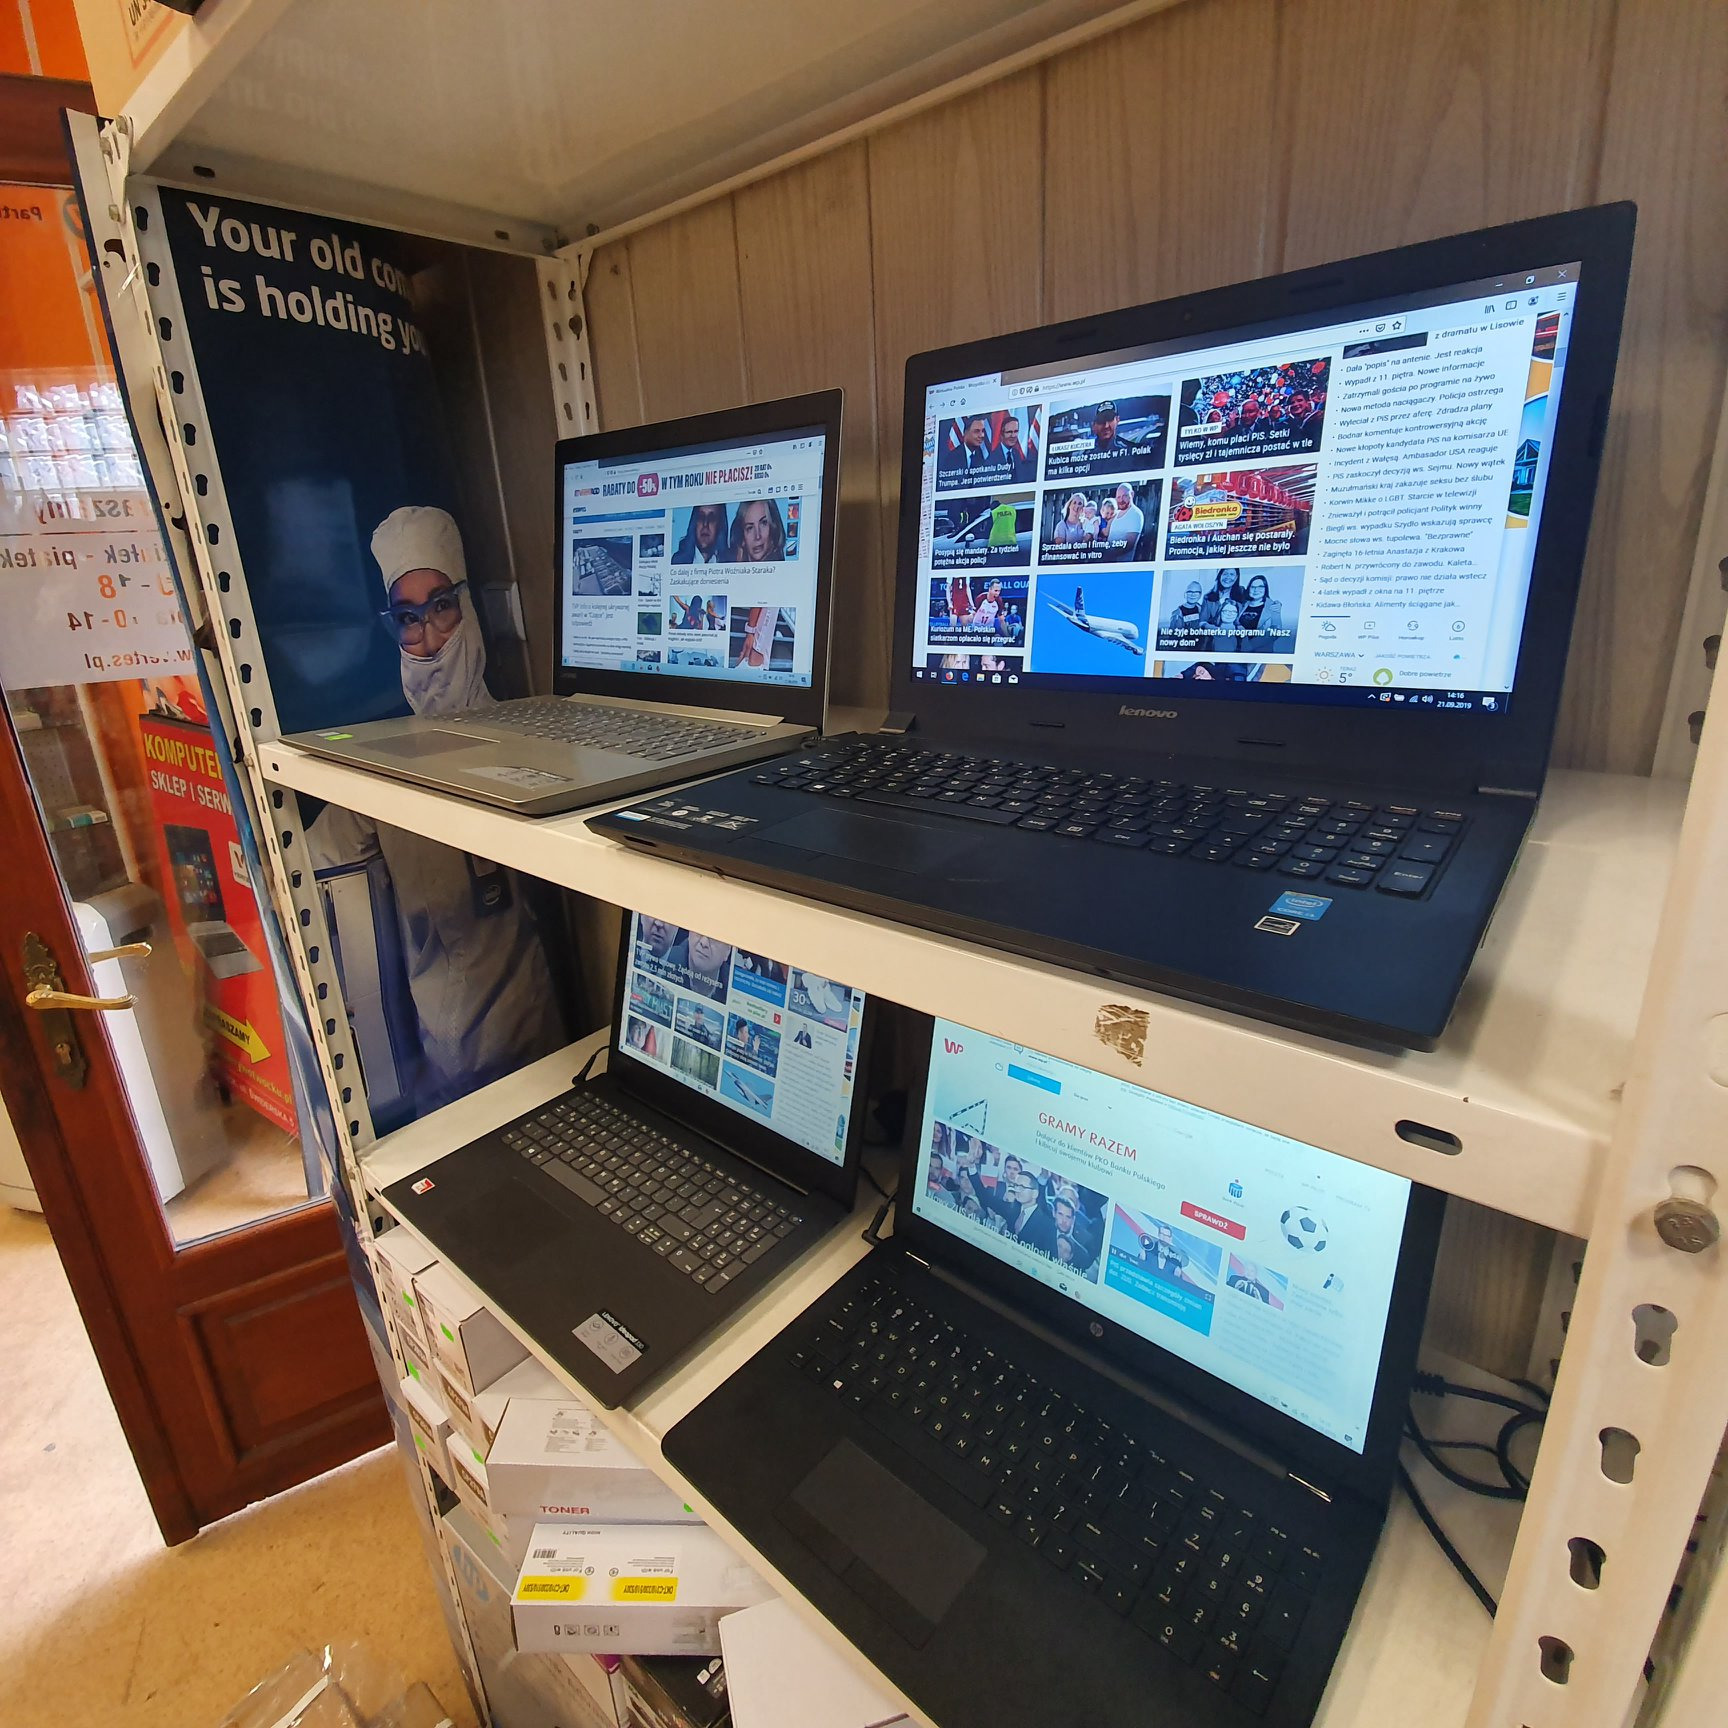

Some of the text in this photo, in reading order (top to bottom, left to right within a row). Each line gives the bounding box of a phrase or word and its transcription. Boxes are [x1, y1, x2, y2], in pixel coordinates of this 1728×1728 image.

[186, 202, 297, 262] Your
[310, 233, 364, 280] old
[201, 266, 246, 313] is
[255, 274, 396, 350] holding
[1408, 384, 1418, 392] po
[1207, 436, 1228, 446] komu
[603, 482, 625, 496] RABATY
[627, 481, 635, 494] DO
[662, 477, 667, 490] W
[669, 475, 683, 489] TYM
[685, 472, 704, 488] ROKU
[705, 470, 717, 485] NIE
[719, 466, 753, 484] PŁACISZ!
[1195, 506, 1237, 514] Biedronka
[1170, 535, 1206, 544] Biedronka
[1212, 533, 1241, 542] Auchan
[1190, 628, 1226, 636] bohaterka
[1228, 628, 1265, 637] programu
[1314, 651, 1355, 659] WARSZAWA
[1119, 705, 1178, 720] lenovo
[151, 770, 187, 798] SKLEP
[1038, 1112, 1137, 1161] GRAMY RAZEM
[1110, 1162, 1131, 1176] Banku
[1132, 1170, 1166, 1191] Polskiego
[540, 1505, 590, 1515] TONER
